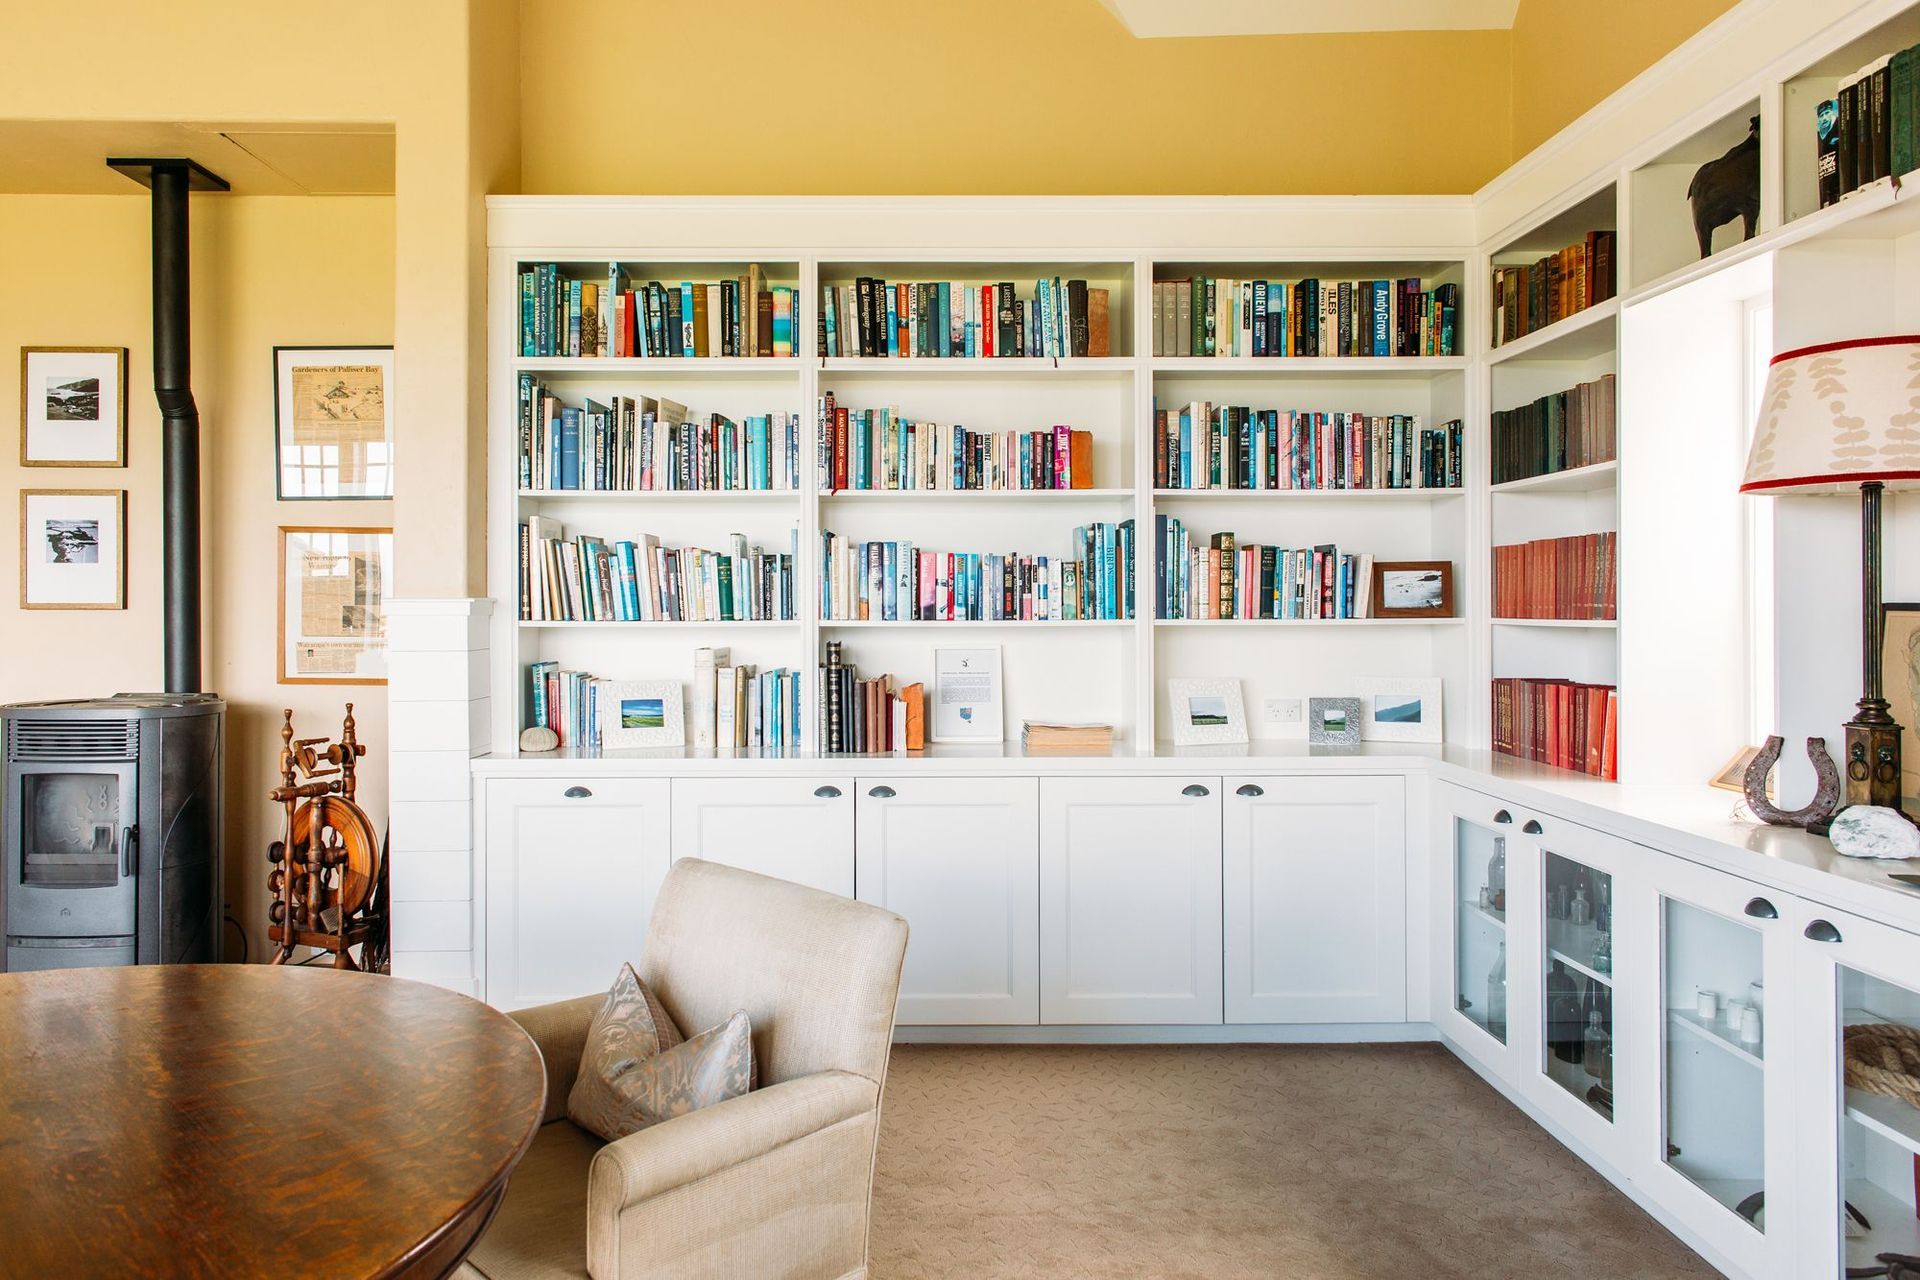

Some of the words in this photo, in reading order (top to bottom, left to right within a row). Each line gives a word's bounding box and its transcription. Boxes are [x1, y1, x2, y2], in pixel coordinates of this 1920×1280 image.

[1003, 286, 1011, 308] LARSSON
[1256, 284, 1266, 316] ORIENT
[1328, 292, 1337, 315] ILES
[1374, 290, 1388, 312] Andy
[862, 295, 870, 329] Hemingway
[1376, 314, 1388, 340] Grove
[365, 366, 379, 374] Bay
